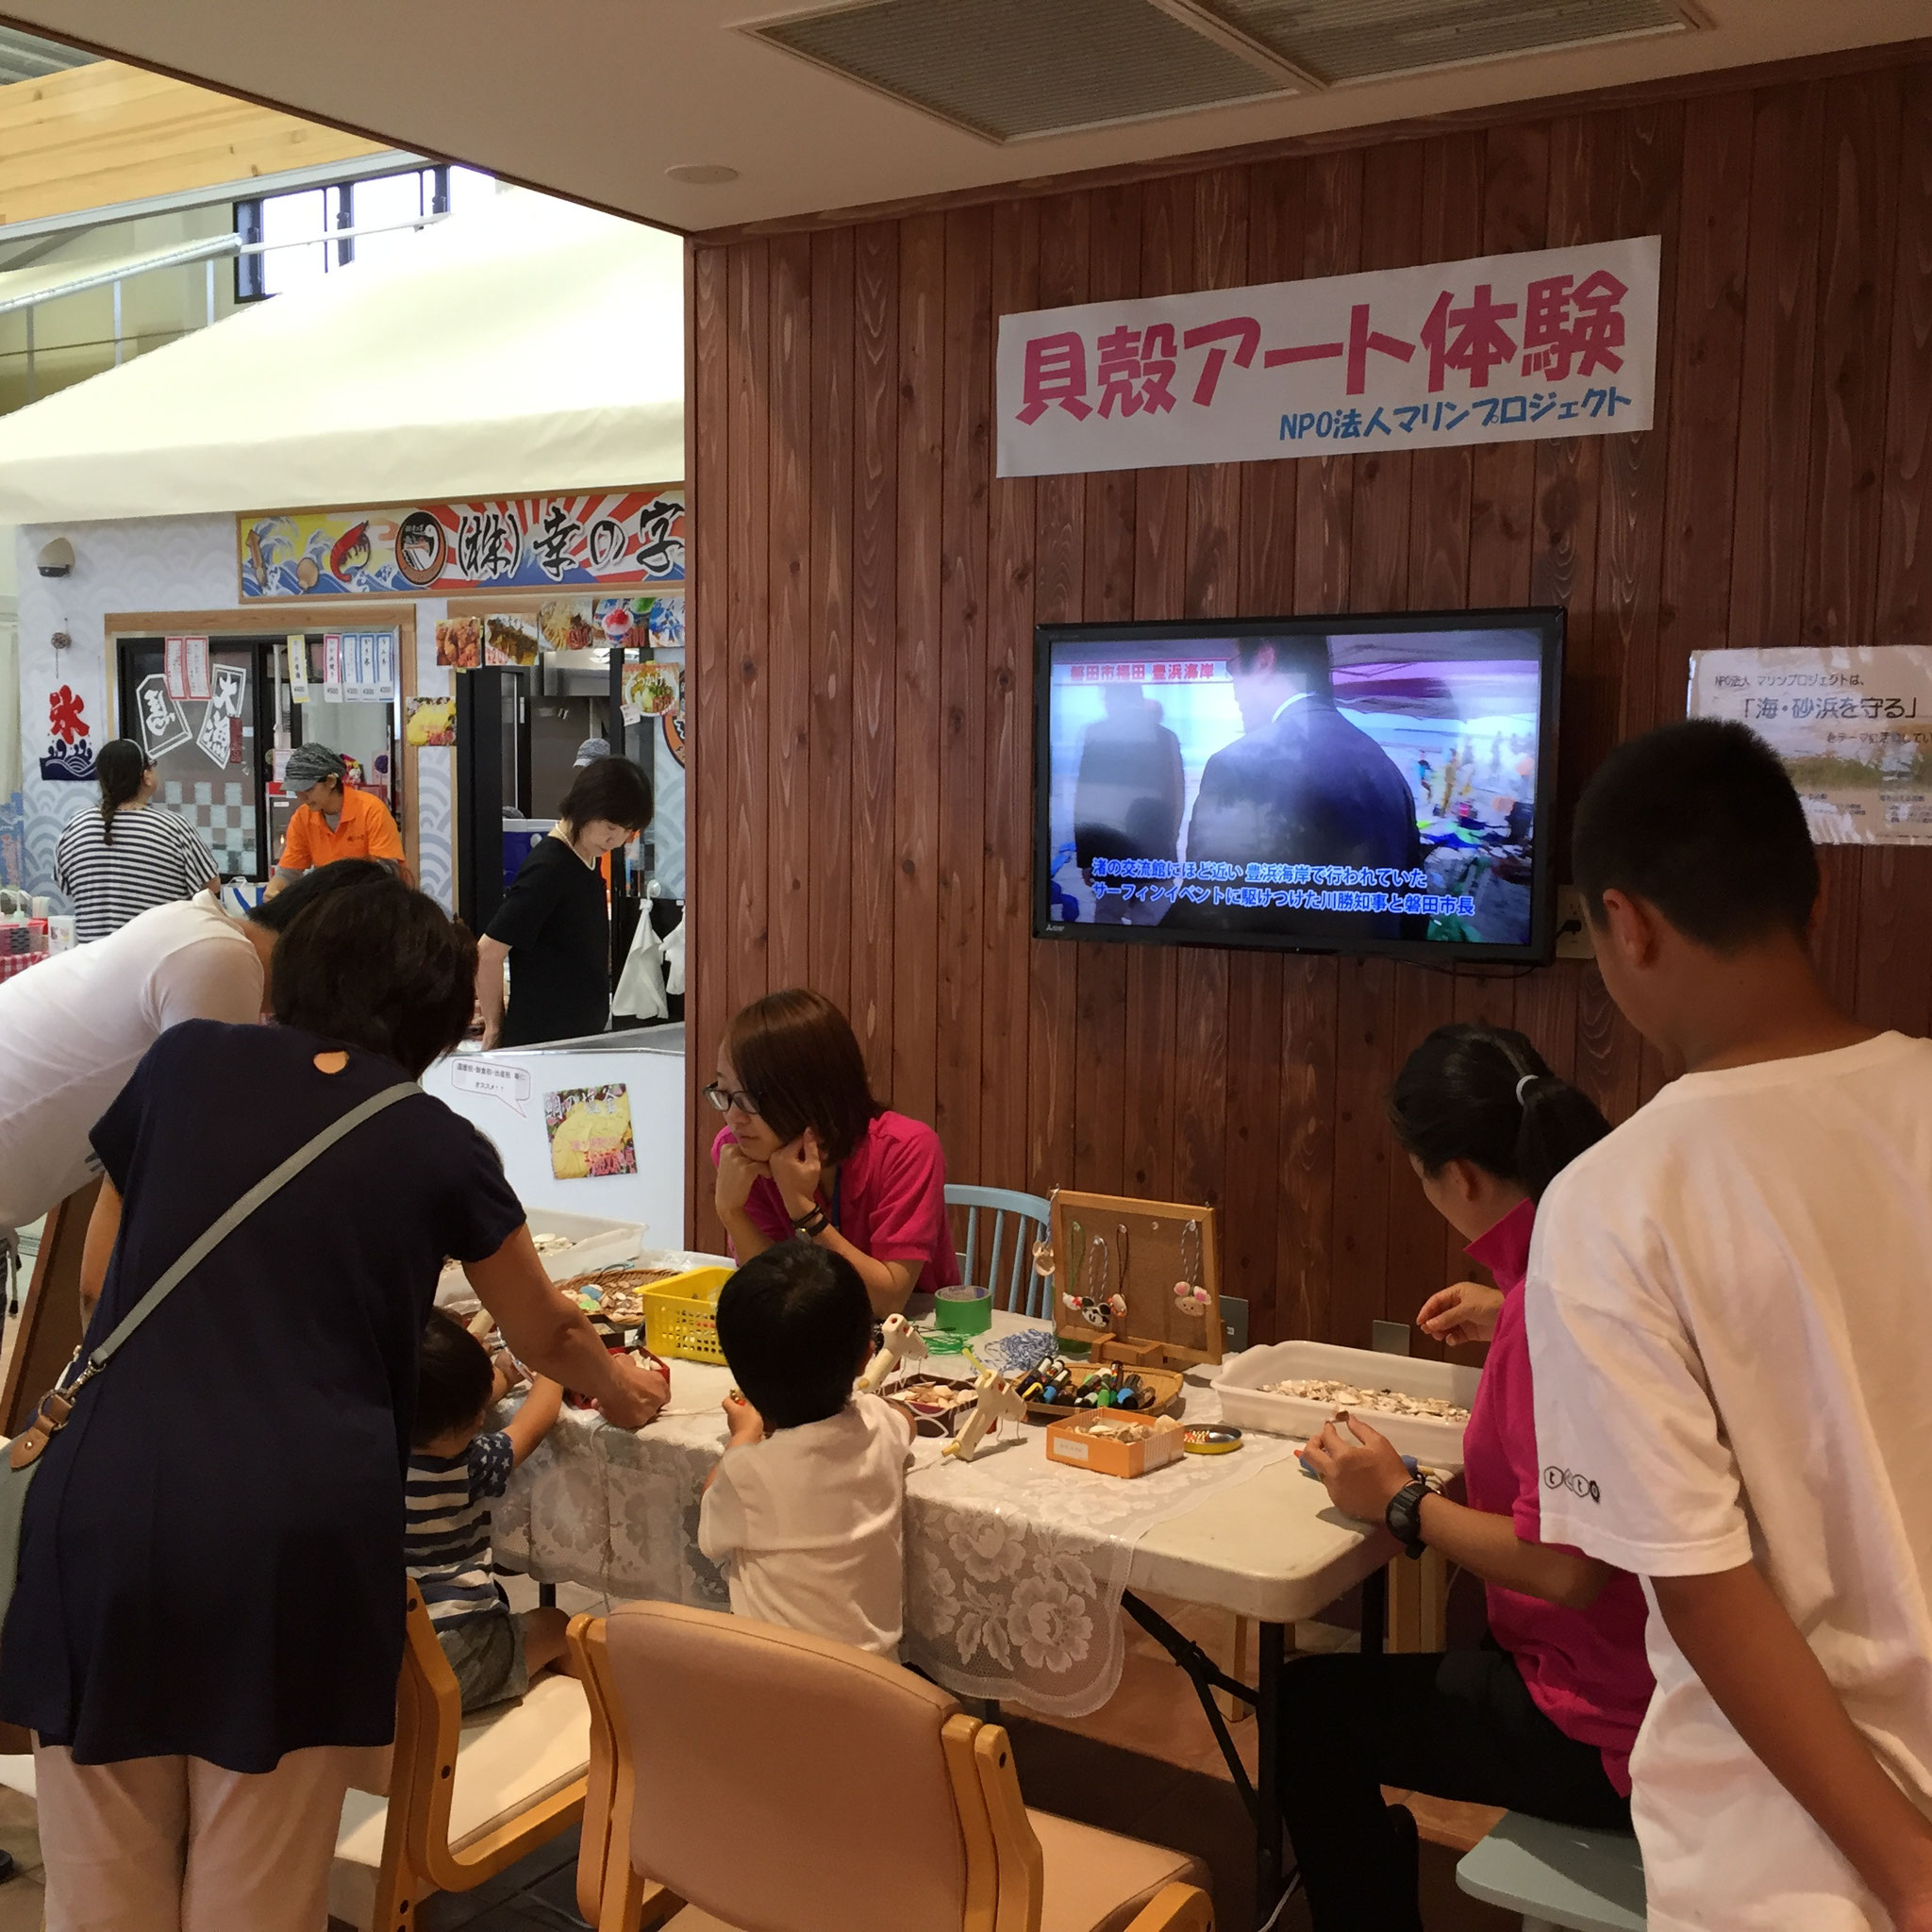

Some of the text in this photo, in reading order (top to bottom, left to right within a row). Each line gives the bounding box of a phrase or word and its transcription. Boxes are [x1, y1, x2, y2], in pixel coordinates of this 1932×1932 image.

[1015, 270, 1629, 425] 貝殻アート体験
[1280, 386, 1632, 441] NPO法人マリンプロジェクト
[1714, 675, 1750, 688] NPO法人
[49, 685, 90, 745] 氷
[1745, 696, 1917, 719] 「海・砂浜を守る」
[1091, 858, 1428, 889] 渚の交流館にほど近い 豊浜海岸で行われていた
[1091, 883, 1475, 918] サーフィンイベントに駆けつけた川勝知事と磐田市長
